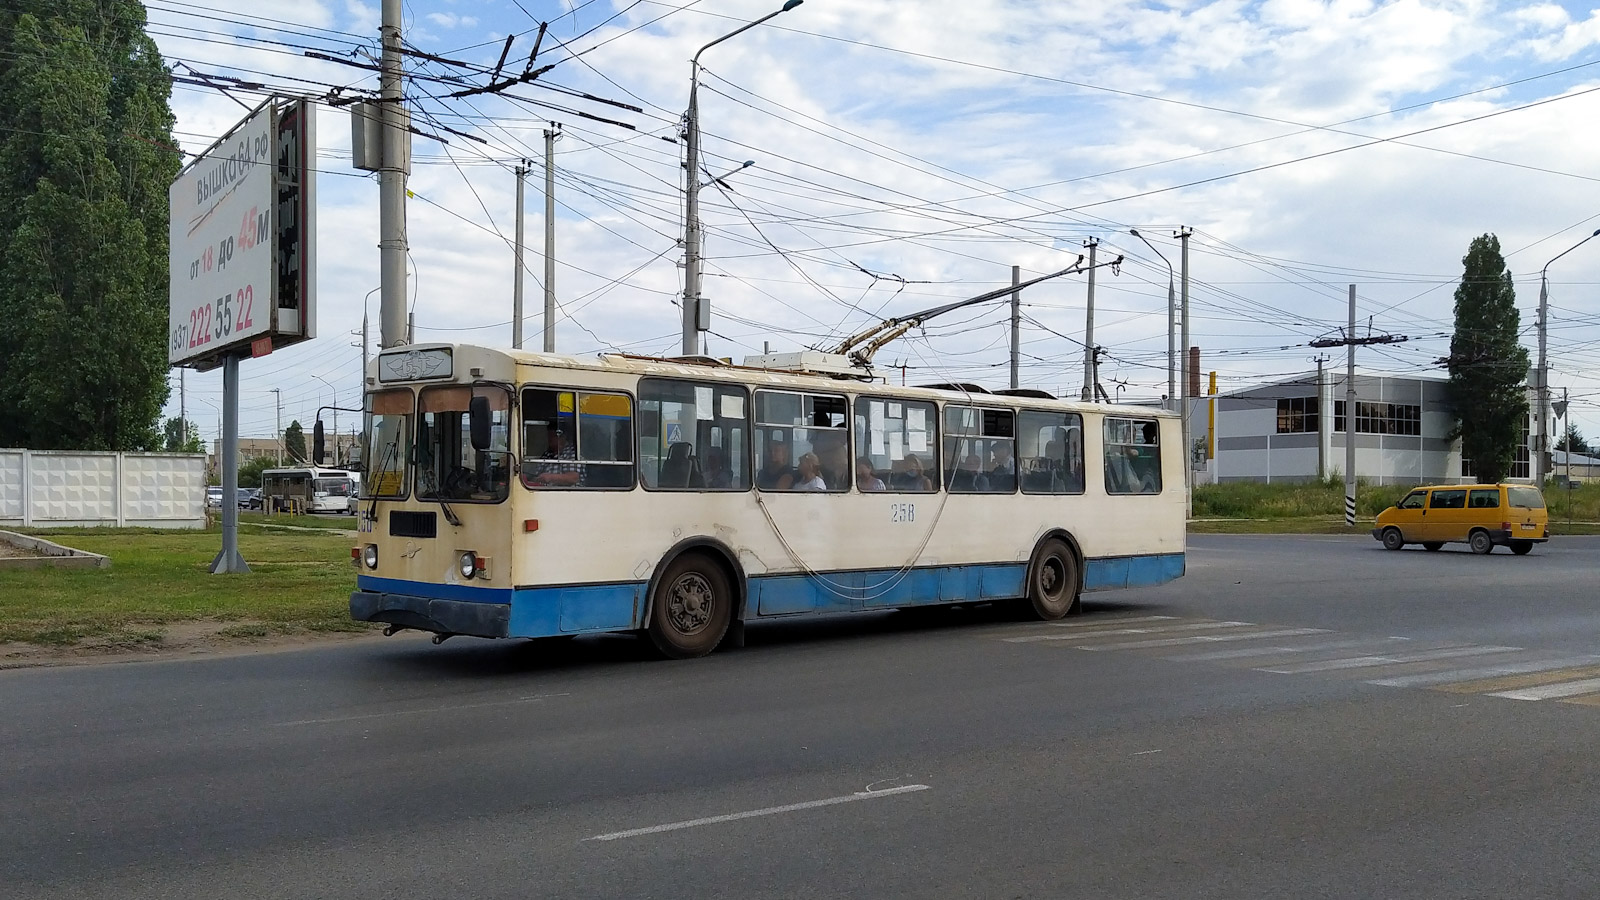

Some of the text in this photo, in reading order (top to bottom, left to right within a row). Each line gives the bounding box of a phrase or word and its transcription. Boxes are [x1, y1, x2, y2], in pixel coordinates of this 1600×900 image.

[202, 246, 213, 273] 18
[189, 303, 212, 349] 222
[215, 293, 232, 340] 55
[235, 284, 253, 332] 22
[891, 503, 915, 522] 258
